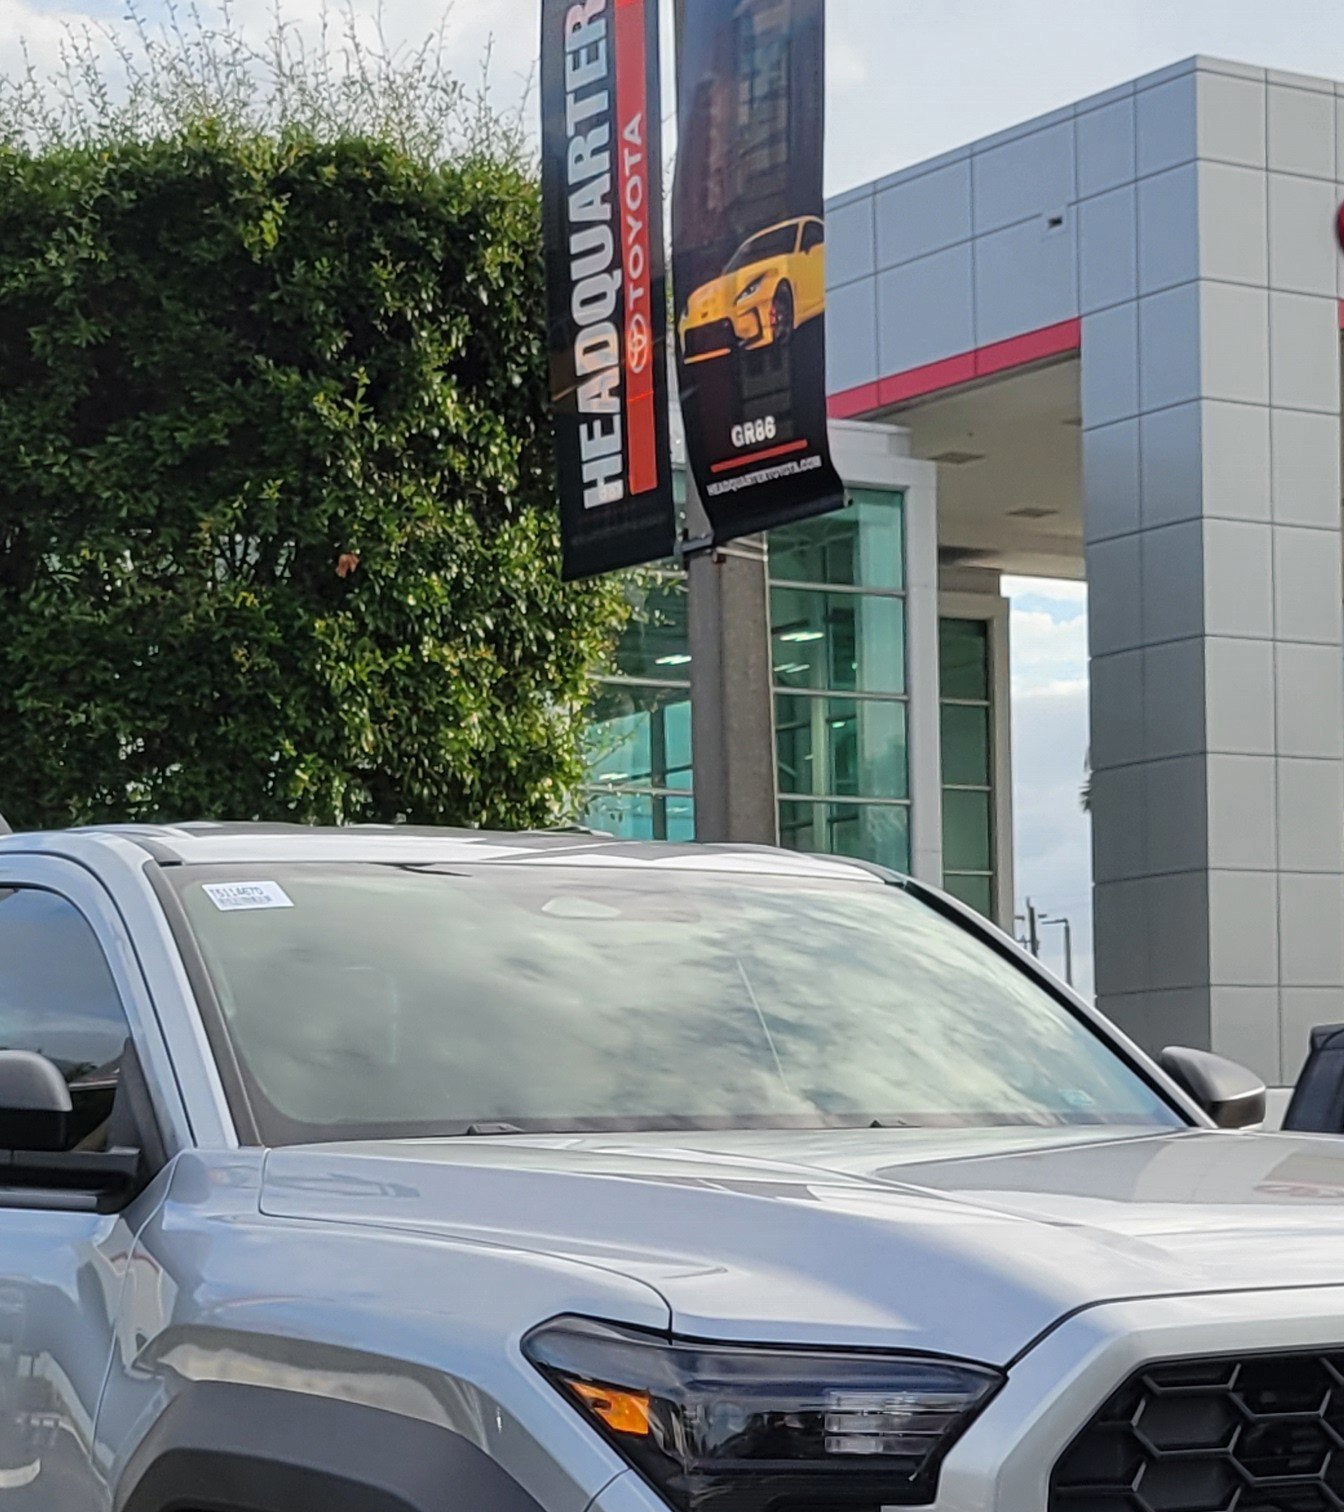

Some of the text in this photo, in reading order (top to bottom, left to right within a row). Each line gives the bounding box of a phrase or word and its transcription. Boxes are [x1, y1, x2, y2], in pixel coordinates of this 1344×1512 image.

[564, 0, 624, 509] HEADQUARTER
[623, 114, 648, 316] TOYOTA
[731, 415, 776, 447] GR86
